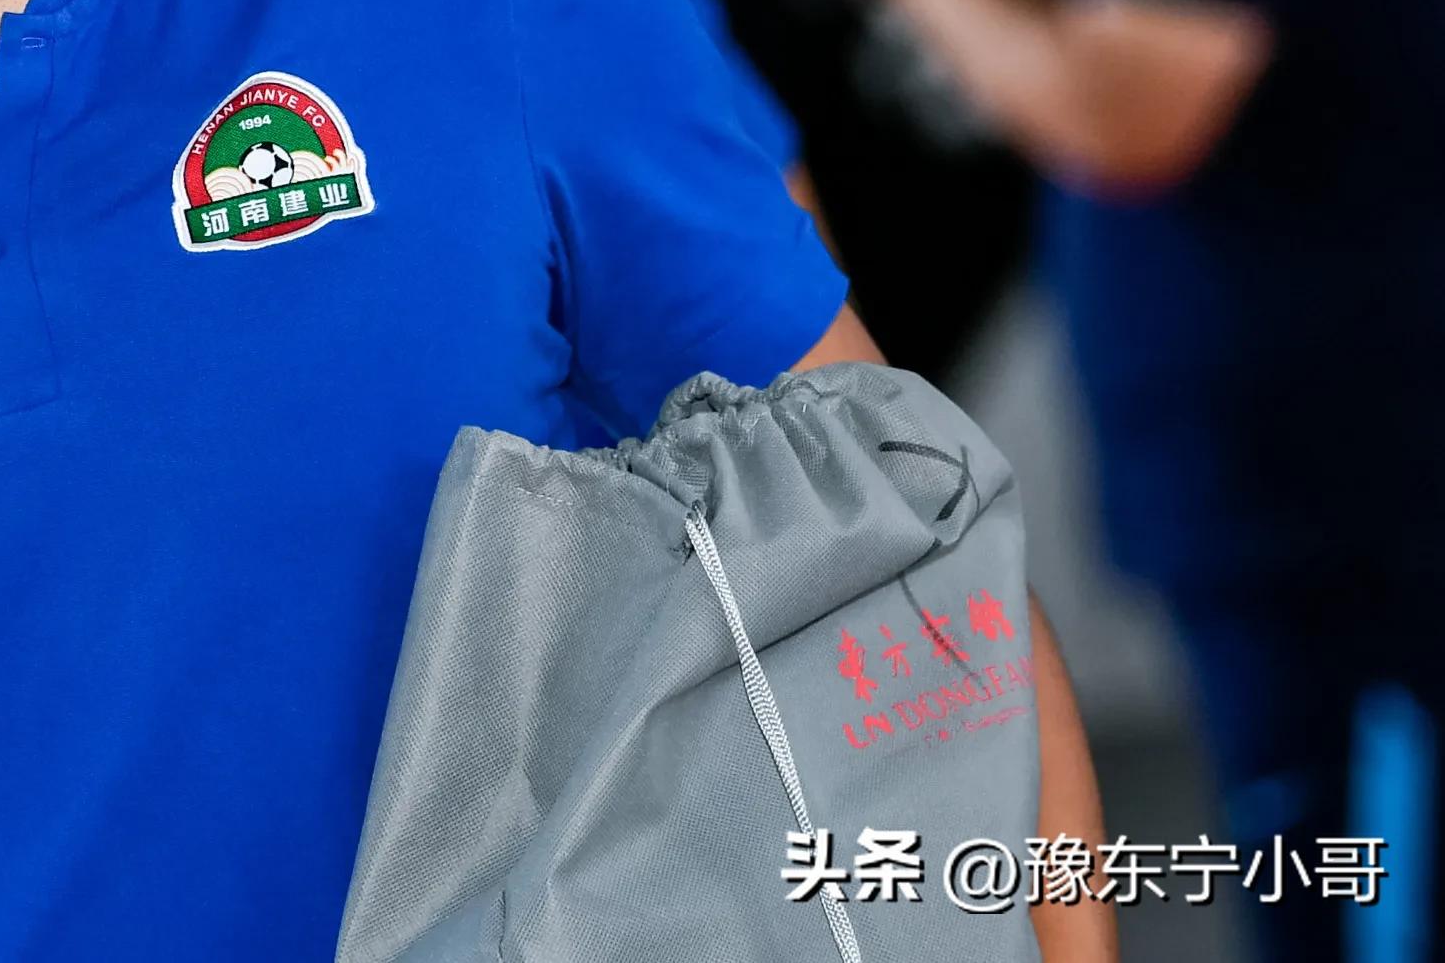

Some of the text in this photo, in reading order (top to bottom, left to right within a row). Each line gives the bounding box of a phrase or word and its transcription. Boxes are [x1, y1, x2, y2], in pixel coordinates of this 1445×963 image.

[191, 88, 326, 155] HENAN JIANYE FC
[238, 114, 272, 131] 1994
[200, 182, 351, 237] 河南建业
